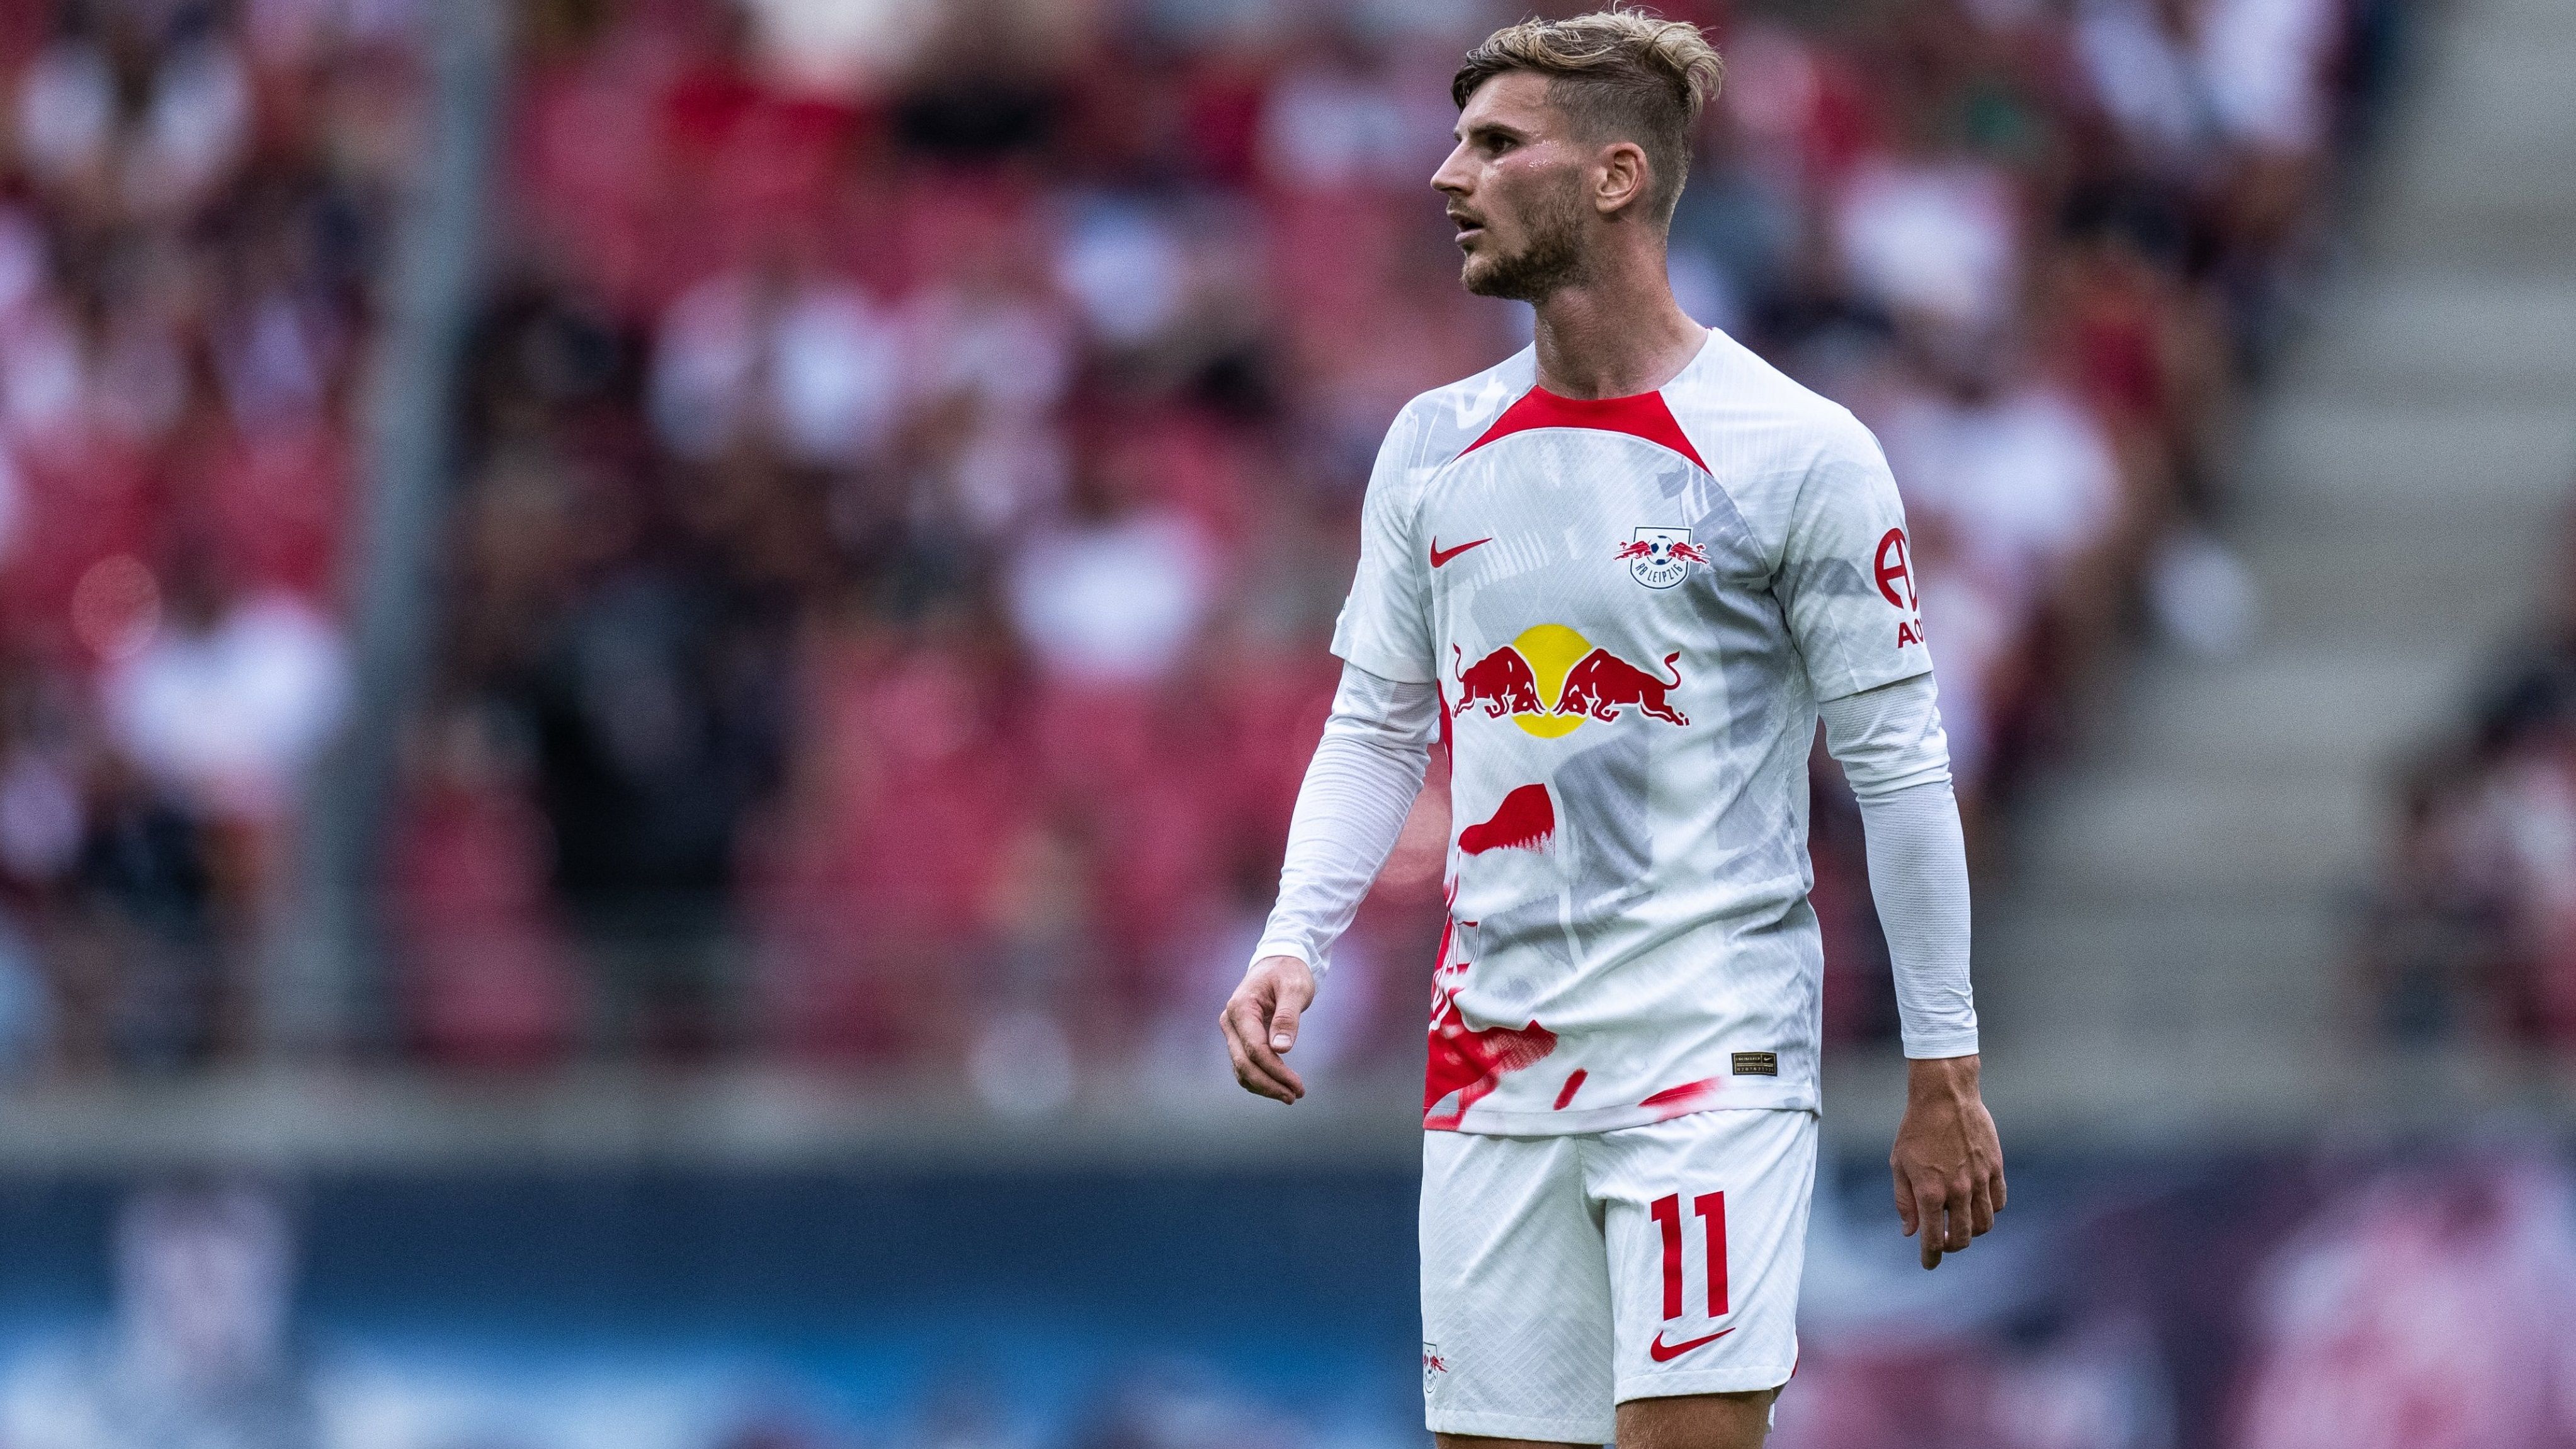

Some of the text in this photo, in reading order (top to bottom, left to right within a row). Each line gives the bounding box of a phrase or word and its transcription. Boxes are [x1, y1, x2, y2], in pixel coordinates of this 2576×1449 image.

[1635, 562, 1683, 582] RB LEIPZIG
[1897, 618, 1924, 649] AO
[1650, 1190, 1729, 1321] 11
